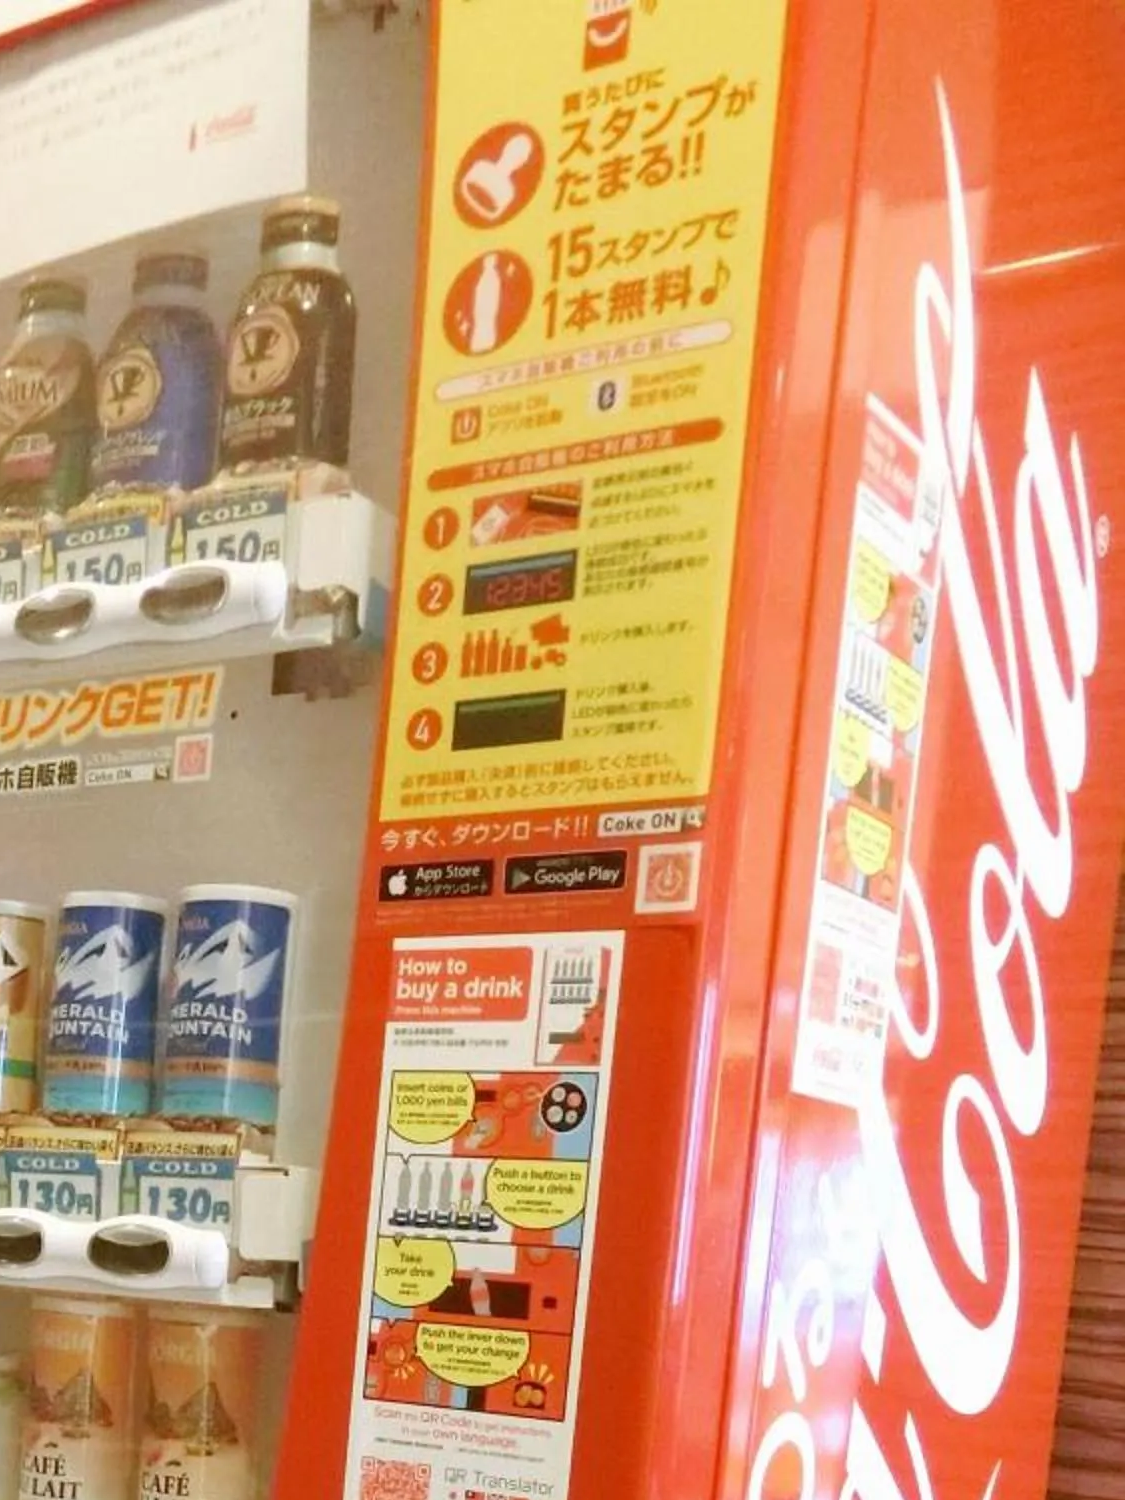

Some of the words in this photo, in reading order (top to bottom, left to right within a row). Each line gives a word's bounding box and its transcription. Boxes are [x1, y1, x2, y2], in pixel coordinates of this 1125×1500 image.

[557, 73, 758, 165] スタンプが
[546, 209, 740, 282] 15スタンプで
[197, 502, 267, 524] COLD
[65, 525, 129, 546] COLD
[65, 553, 142, 586] 150円
[603, 814, 648, 834] Coke
[650, 811, 677, 830] ON
[415, 864, 444, 883] App
[445, 863, 482, 880] Store
[534, 866, 586, 886] Google
[587, 865, 621, 884] Play
[398, 958, 442, 977] How
[446, 957, 468, 975] to
[395, 980, 439, 1003] buy
[444, 983, 459, 999] a
[464, 976, 524, 999] drink
[427, 1083, 454, 1095] coins
[17, 1157, 80, 1172] COLD
[148, 1160, 218, 1176] COLD
[493, 1166, 520, 1180] Push
[530, 1169, 569, 1182] button
[24, 1177, 93, 1216] 130円
[148, 1185, 231, 1224] 130円
[141, 1470, 191, 1498] CAFÉ
[474, 1468, 555, 1496] Translator
